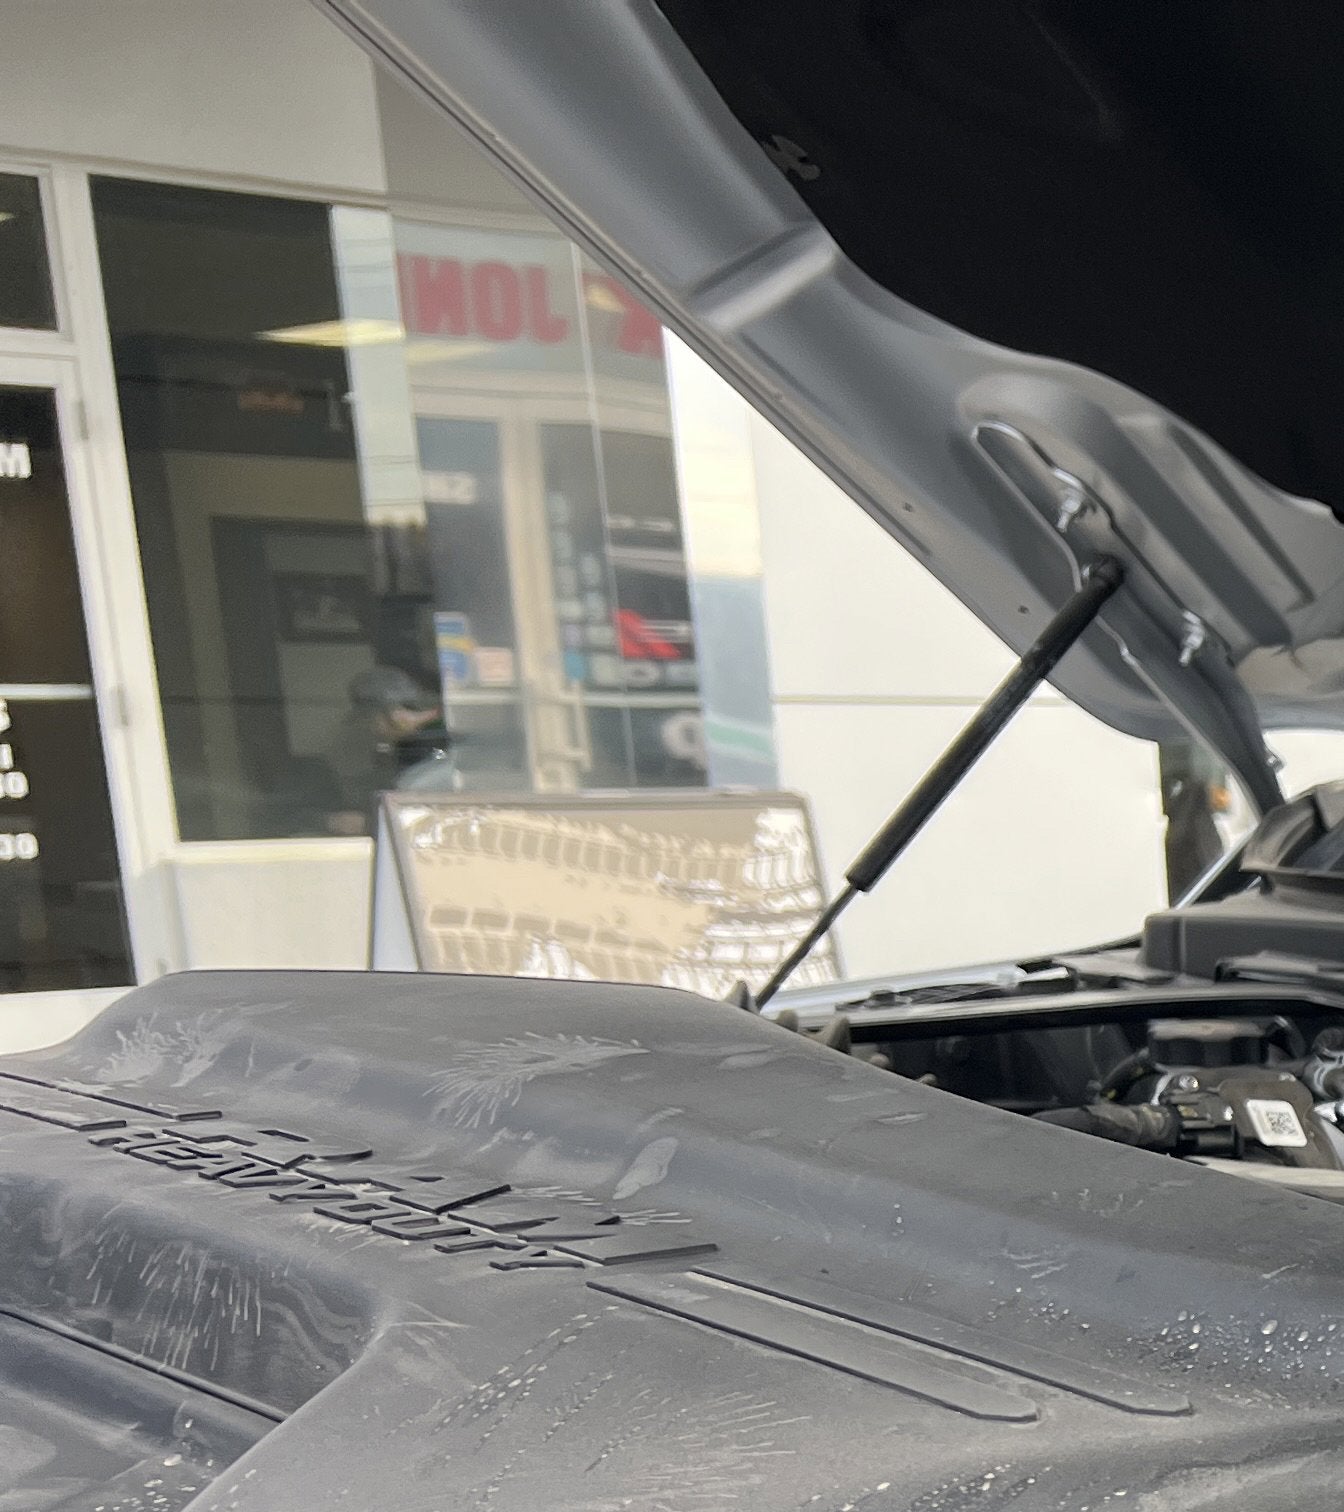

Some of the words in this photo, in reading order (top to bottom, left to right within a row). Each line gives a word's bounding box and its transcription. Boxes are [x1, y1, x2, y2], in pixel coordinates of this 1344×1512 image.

[87, 1131, 358, 1202] HEAVY
[313, 1195, 585, 1271] DUTY
[161, 1122, 719, 1266] RAM
